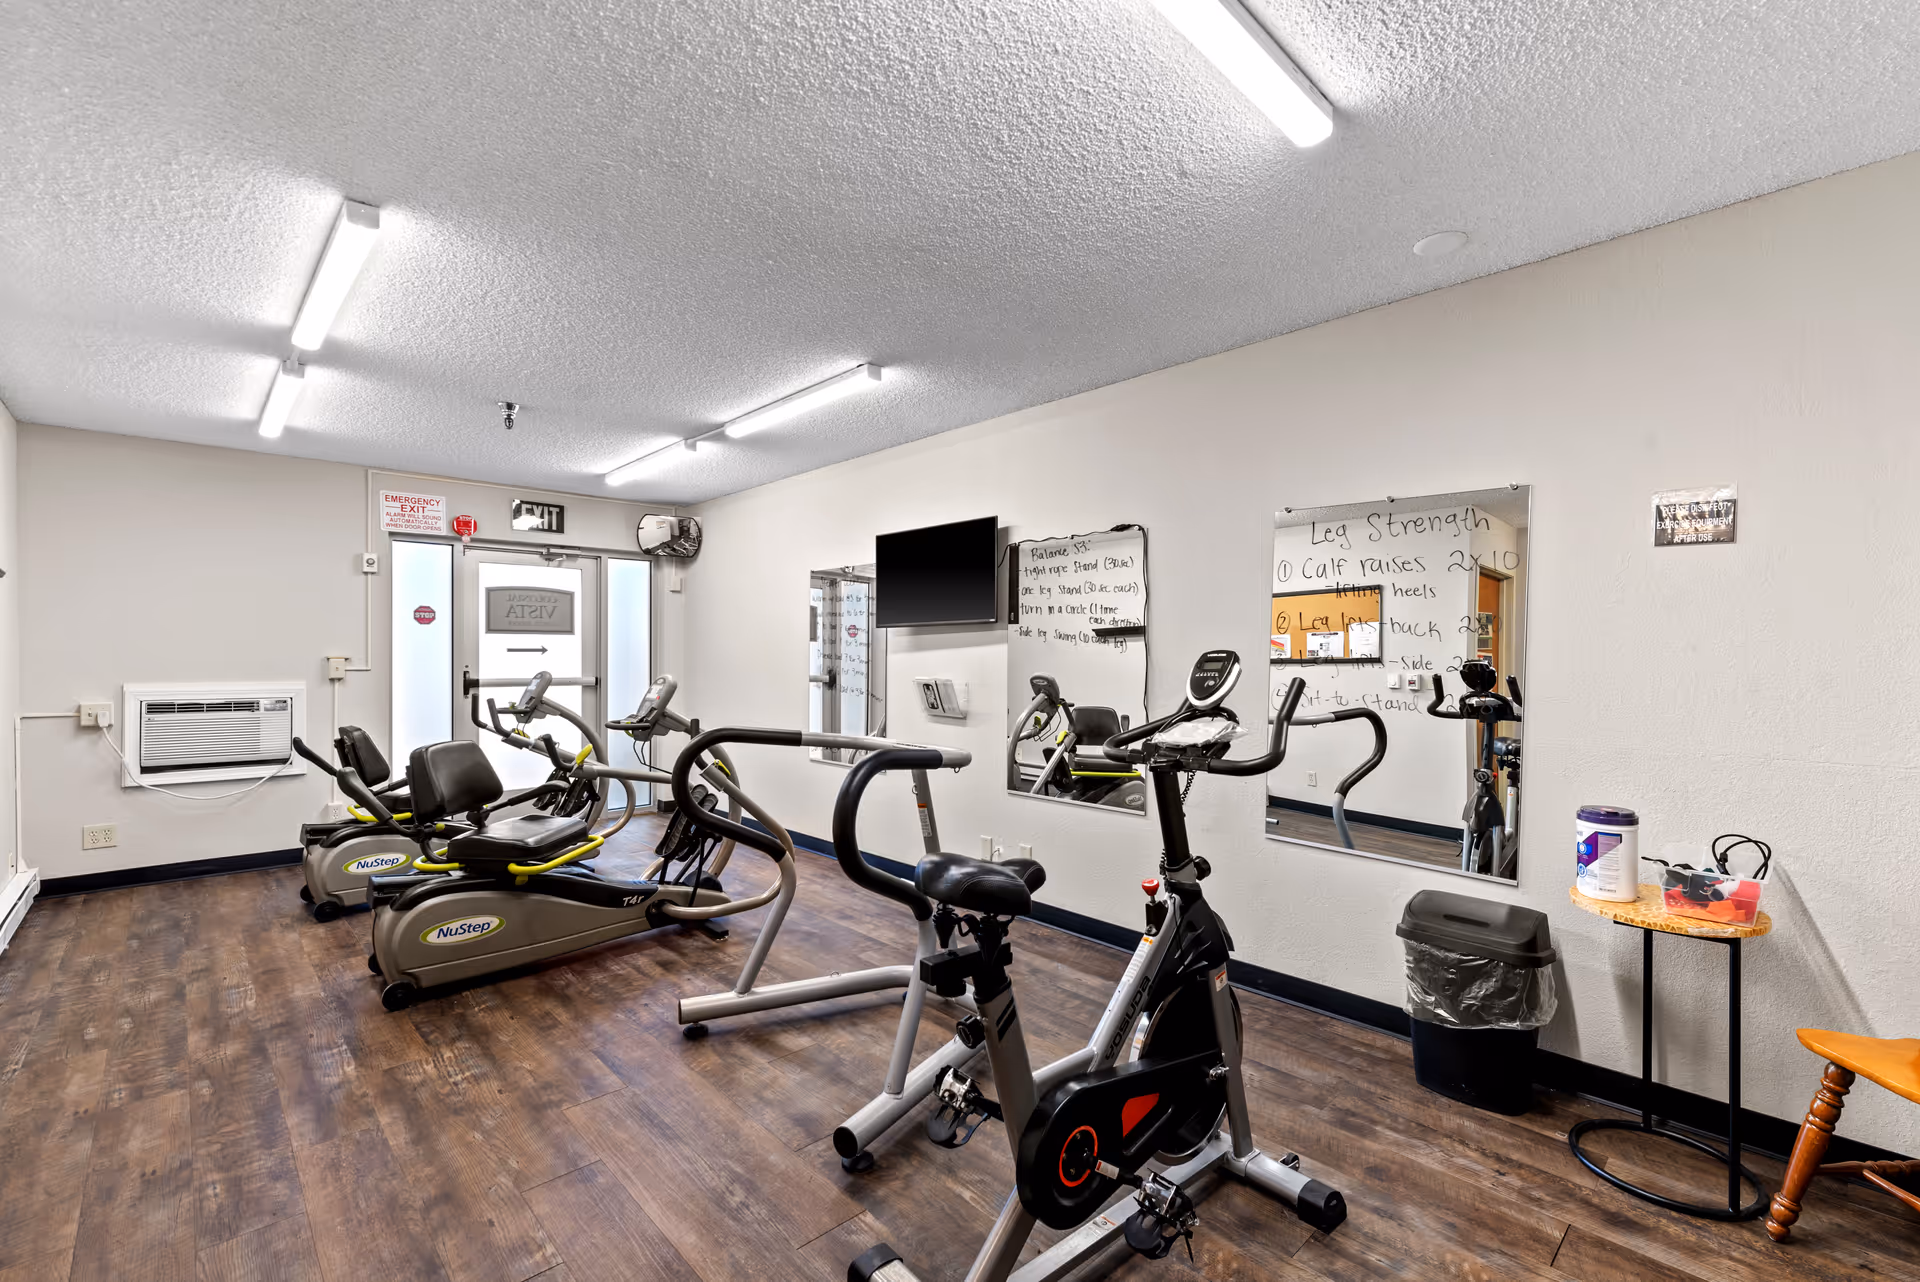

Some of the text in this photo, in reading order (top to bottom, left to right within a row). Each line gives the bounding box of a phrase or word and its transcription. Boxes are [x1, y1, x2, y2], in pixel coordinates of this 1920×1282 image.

[384, 494, 441, 507] EMERGENCY
[400, 504, 427, 514] EXIT
[389, 517, 438, 526] AUTOMATICALLY
[1311, 507, 1491, 550] Leg Strength
[1030, 547, 1069, 562] Balance
[1048, 566, 1068, 577] rope
[1302, 558, 1349, 580] Calf
[1360, 553, 1427, 578] raises
[1392, 582, 1437, 600] heels
[1020, 602, 1042, 616] turn
[1058, 605, 1062, 614] a
[1299, 612, 1332, 633] Leg
[356, 857, 400, 870] NuStep
[436, 922, 492, 939] NuStep
